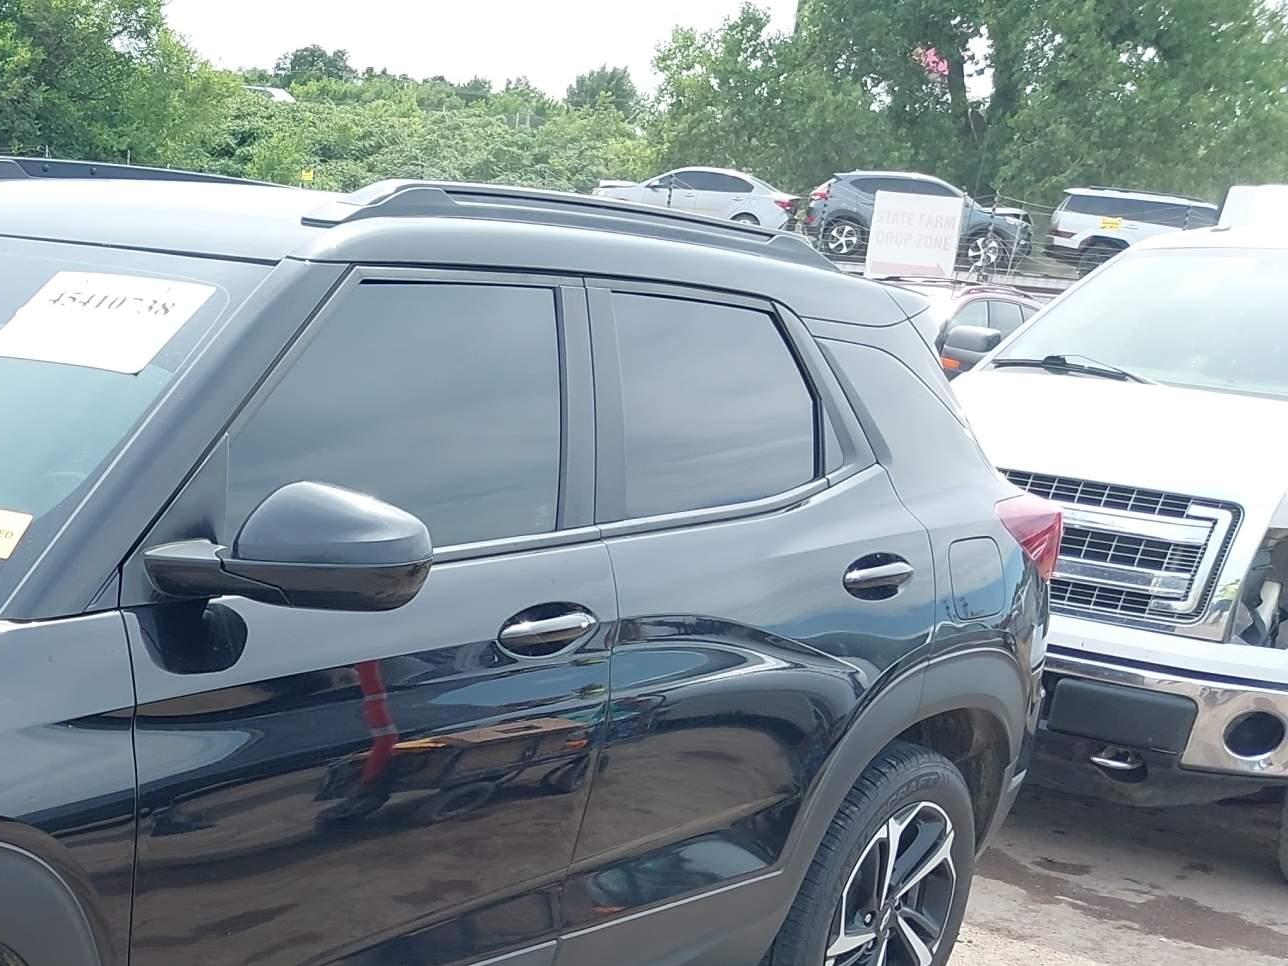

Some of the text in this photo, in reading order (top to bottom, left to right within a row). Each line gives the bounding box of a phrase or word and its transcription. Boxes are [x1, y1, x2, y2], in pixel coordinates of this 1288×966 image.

[877, 210, 956, 230] STATE FARM
[876, 231, 952, 251] DROP ZONE
